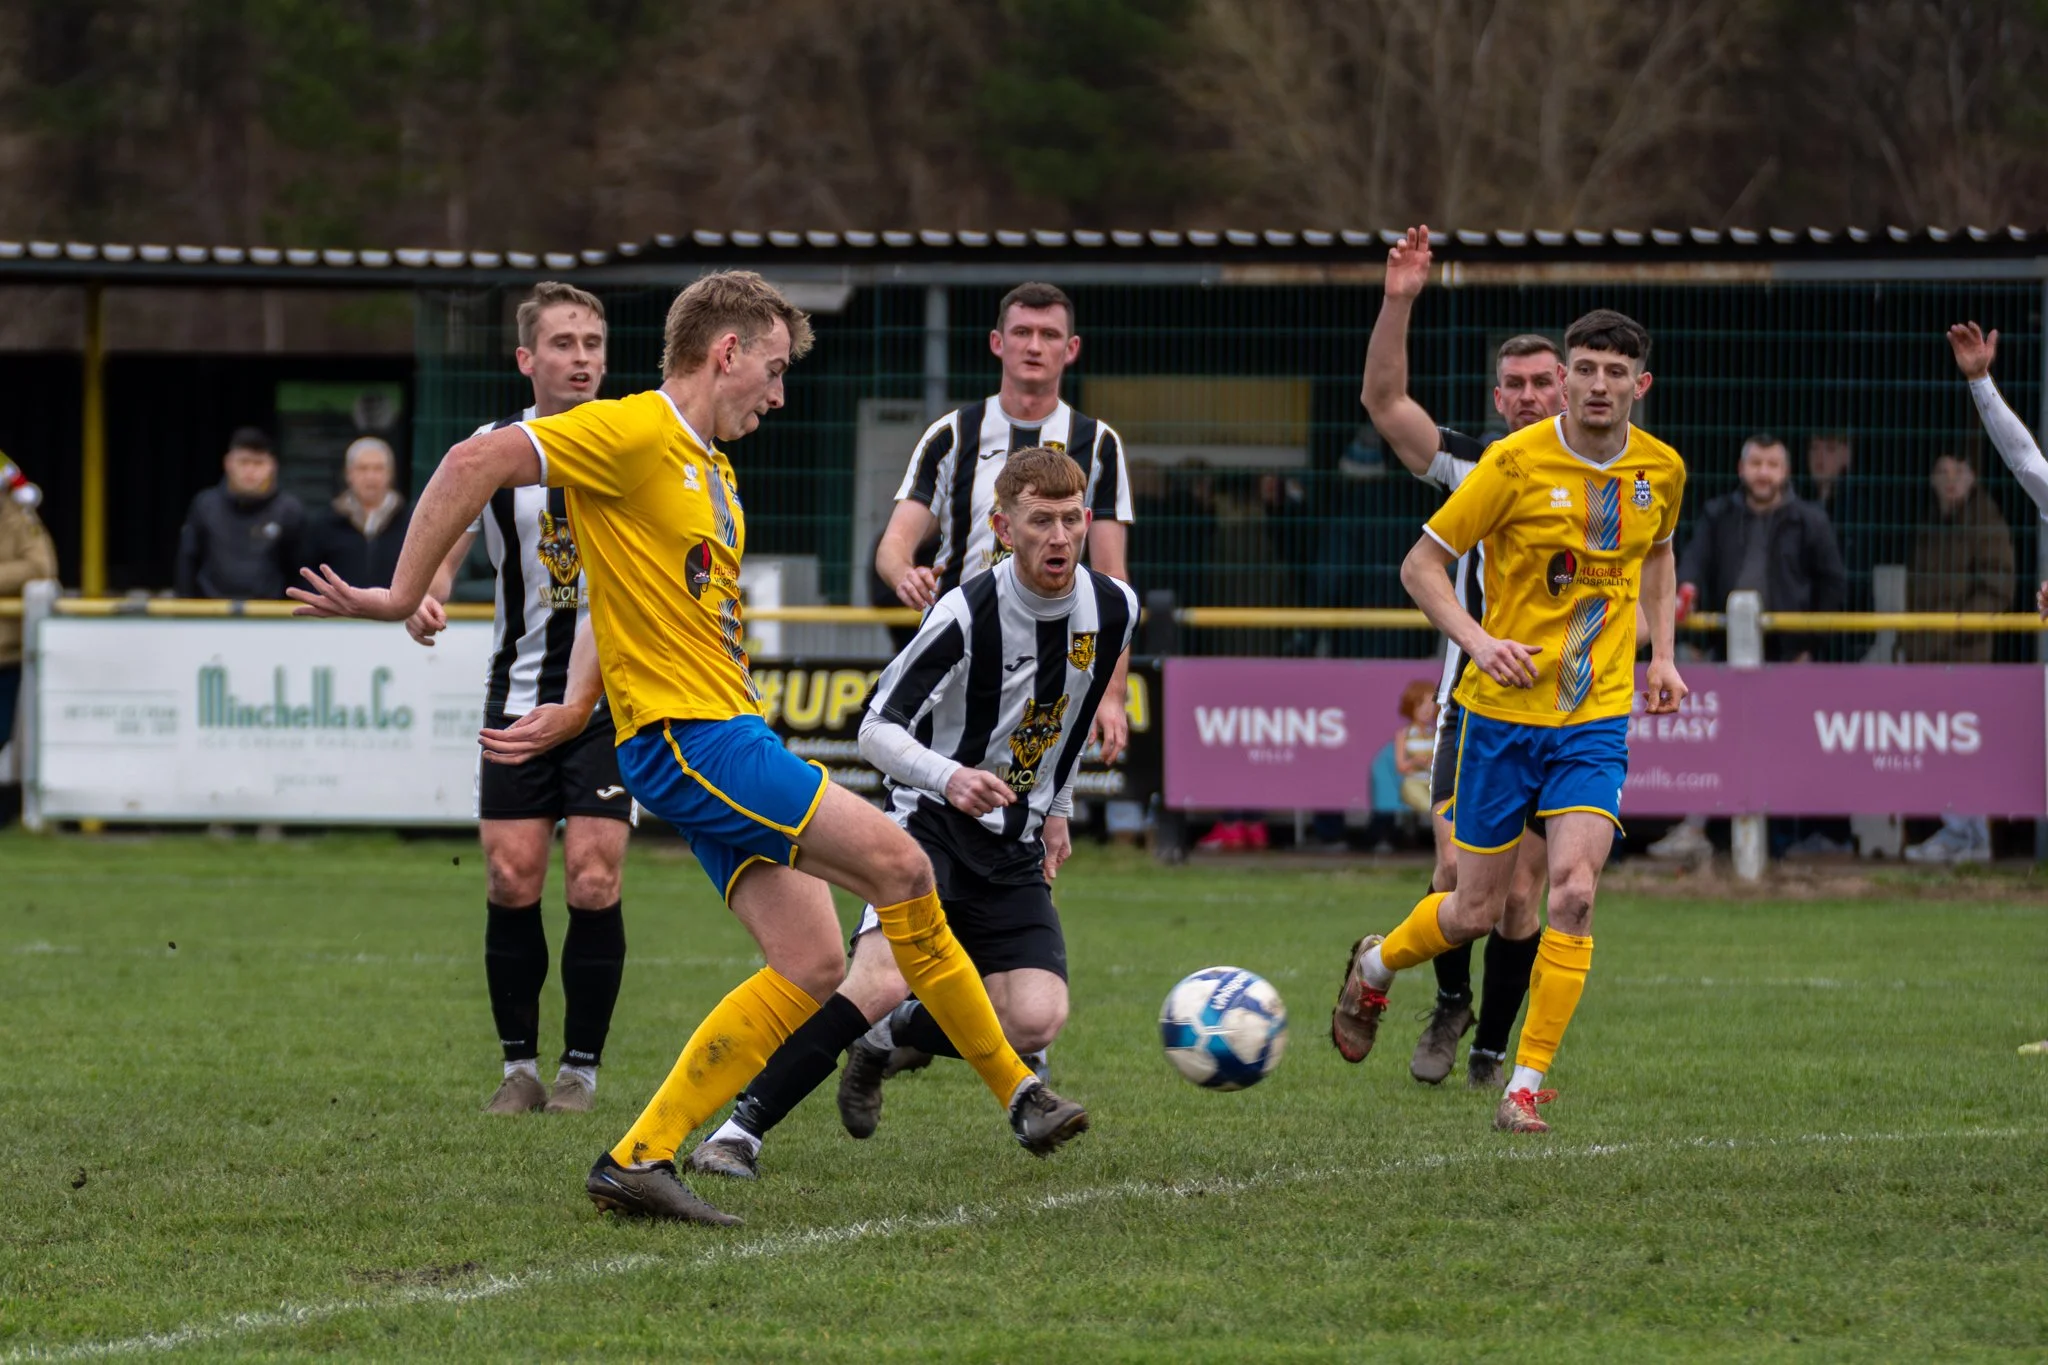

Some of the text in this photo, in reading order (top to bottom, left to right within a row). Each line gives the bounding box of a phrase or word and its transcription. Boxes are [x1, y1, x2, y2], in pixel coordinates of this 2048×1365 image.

[1195, 706, 1347, 745] WINNS
[1657, 716, 1718, 740] EASY
[1814, 711, 1981, 753] WINNS
